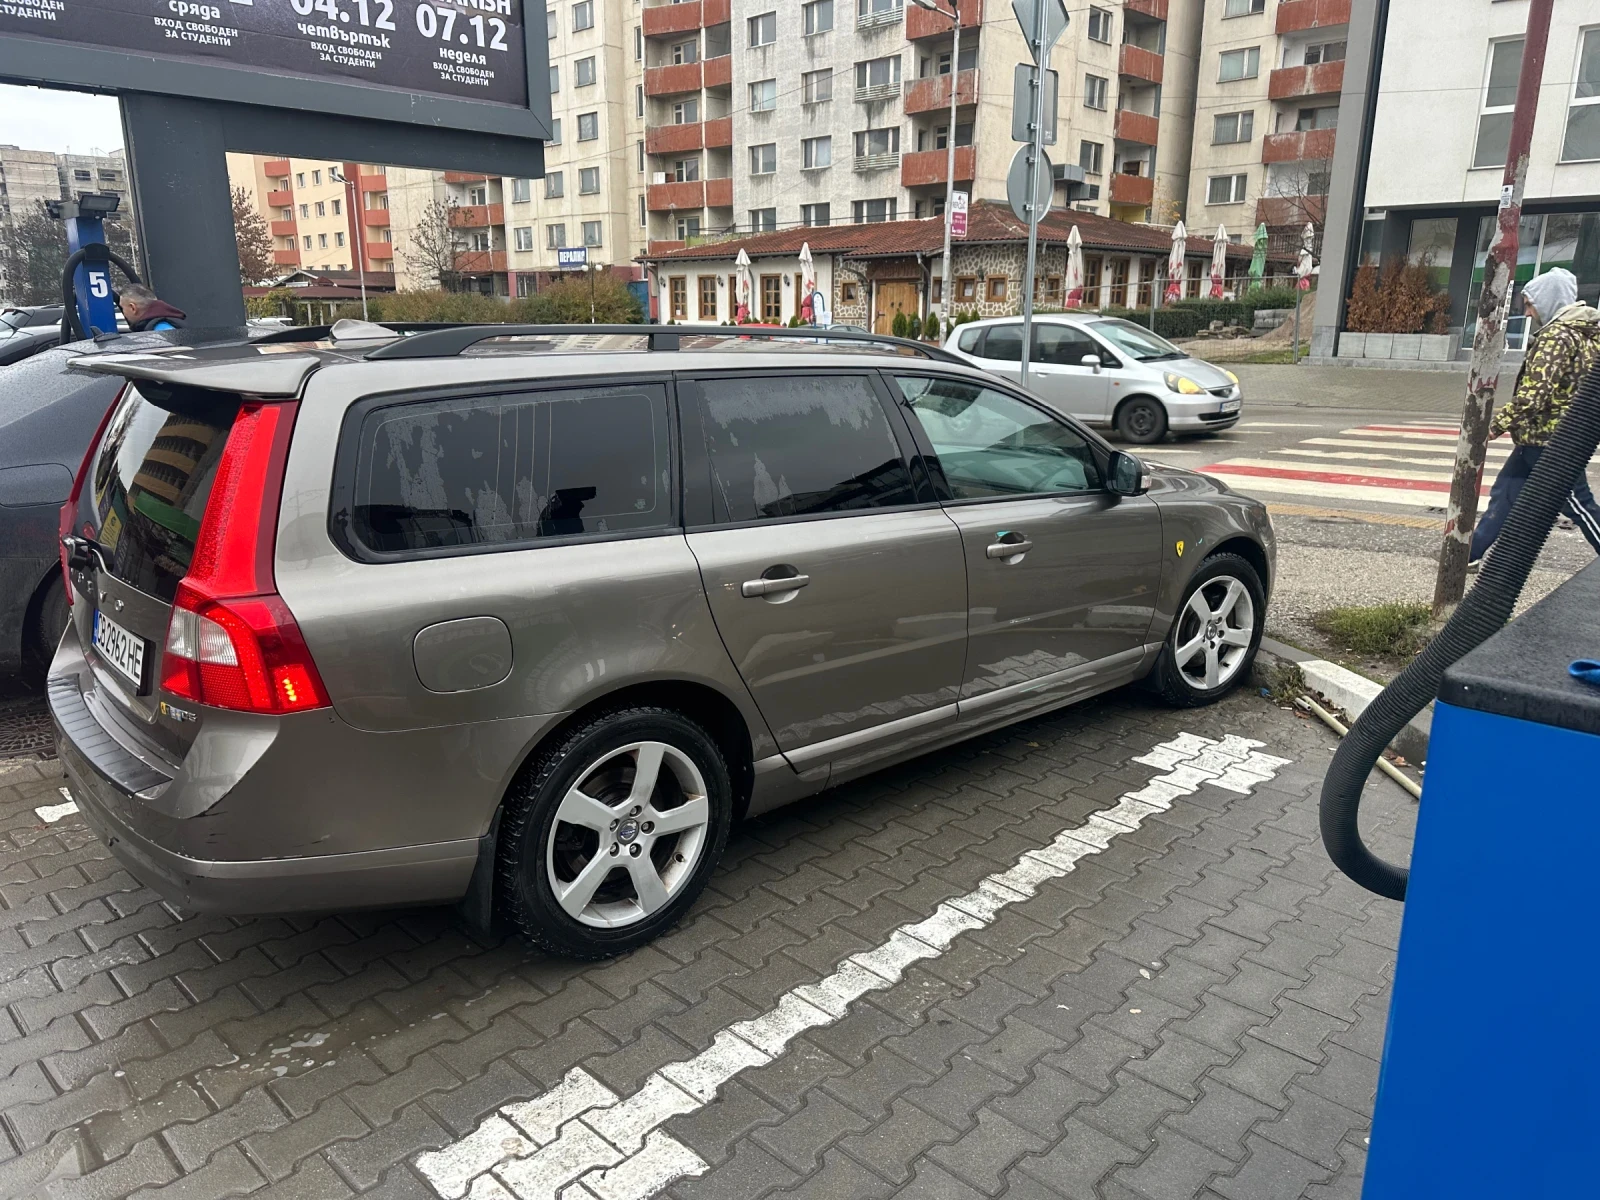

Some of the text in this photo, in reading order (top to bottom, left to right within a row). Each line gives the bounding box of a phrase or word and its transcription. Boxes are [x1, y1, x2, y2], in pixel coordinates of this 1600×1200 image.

[168, 0, 220, 20] сряда
[153, 16, 239, 37] ВХОД СВОБОДЕН
[297, 22, 391, 49] четвъртък
[415, 3, 508, 52] 07.12
[164, 28, 231, 47] ЗА СТУДЕНТИ
[310, 41, 382, 60] ВХОД СВОБОДЕН
[439, 47, 487, 65] неделя
[319, 52, 376, 69] ЗА СТУДЕНТИ
[432, 61, 495, 79] ВХОД СВОБОДЕН
[440, 72, 489, 87] ЗА СТУДЕНТИ
[88, 271, 109, 298] 5
